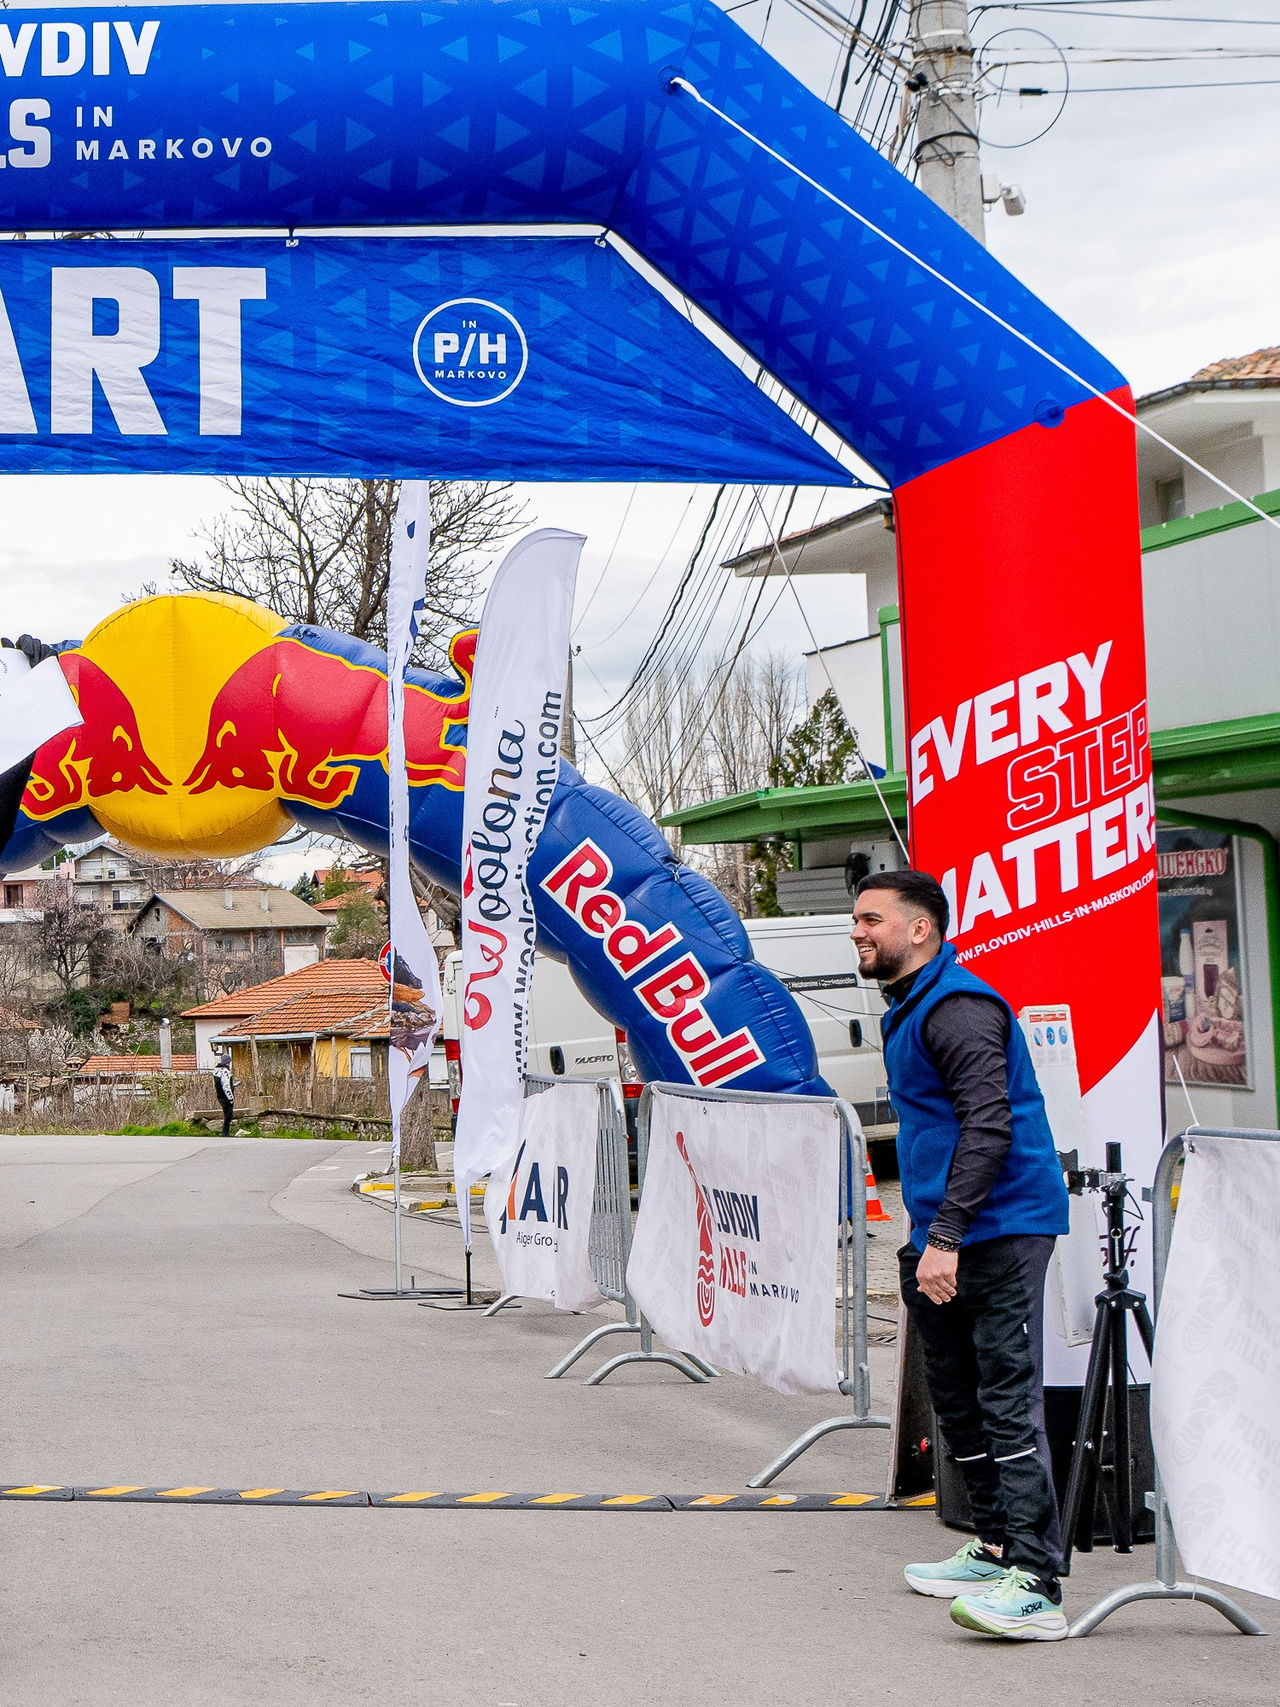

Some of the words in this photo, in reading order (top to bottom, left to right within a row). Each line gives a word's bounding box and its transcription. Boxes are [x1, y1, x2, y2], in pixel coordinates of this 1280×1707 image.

[76, 106, 114, 128] IN
[76, 136, 273, 162] MARKOVO
[462, 320, 477, 329] IN
[434, 332, 507, 367] P/H
[434, 370, 507, 380] MARKOVO
[911, 640, 1113, 808] EVERY
[1007, 699, 1150, 831] STEP
[544, 842, 681, 973] Red
[638, 954, 762, 1087] Bull
[516, 1231, 533, 1247] Aiger
[748, 1260, 758, 1275] IN
[1021, 1601, 1043, 1616] HOKA
